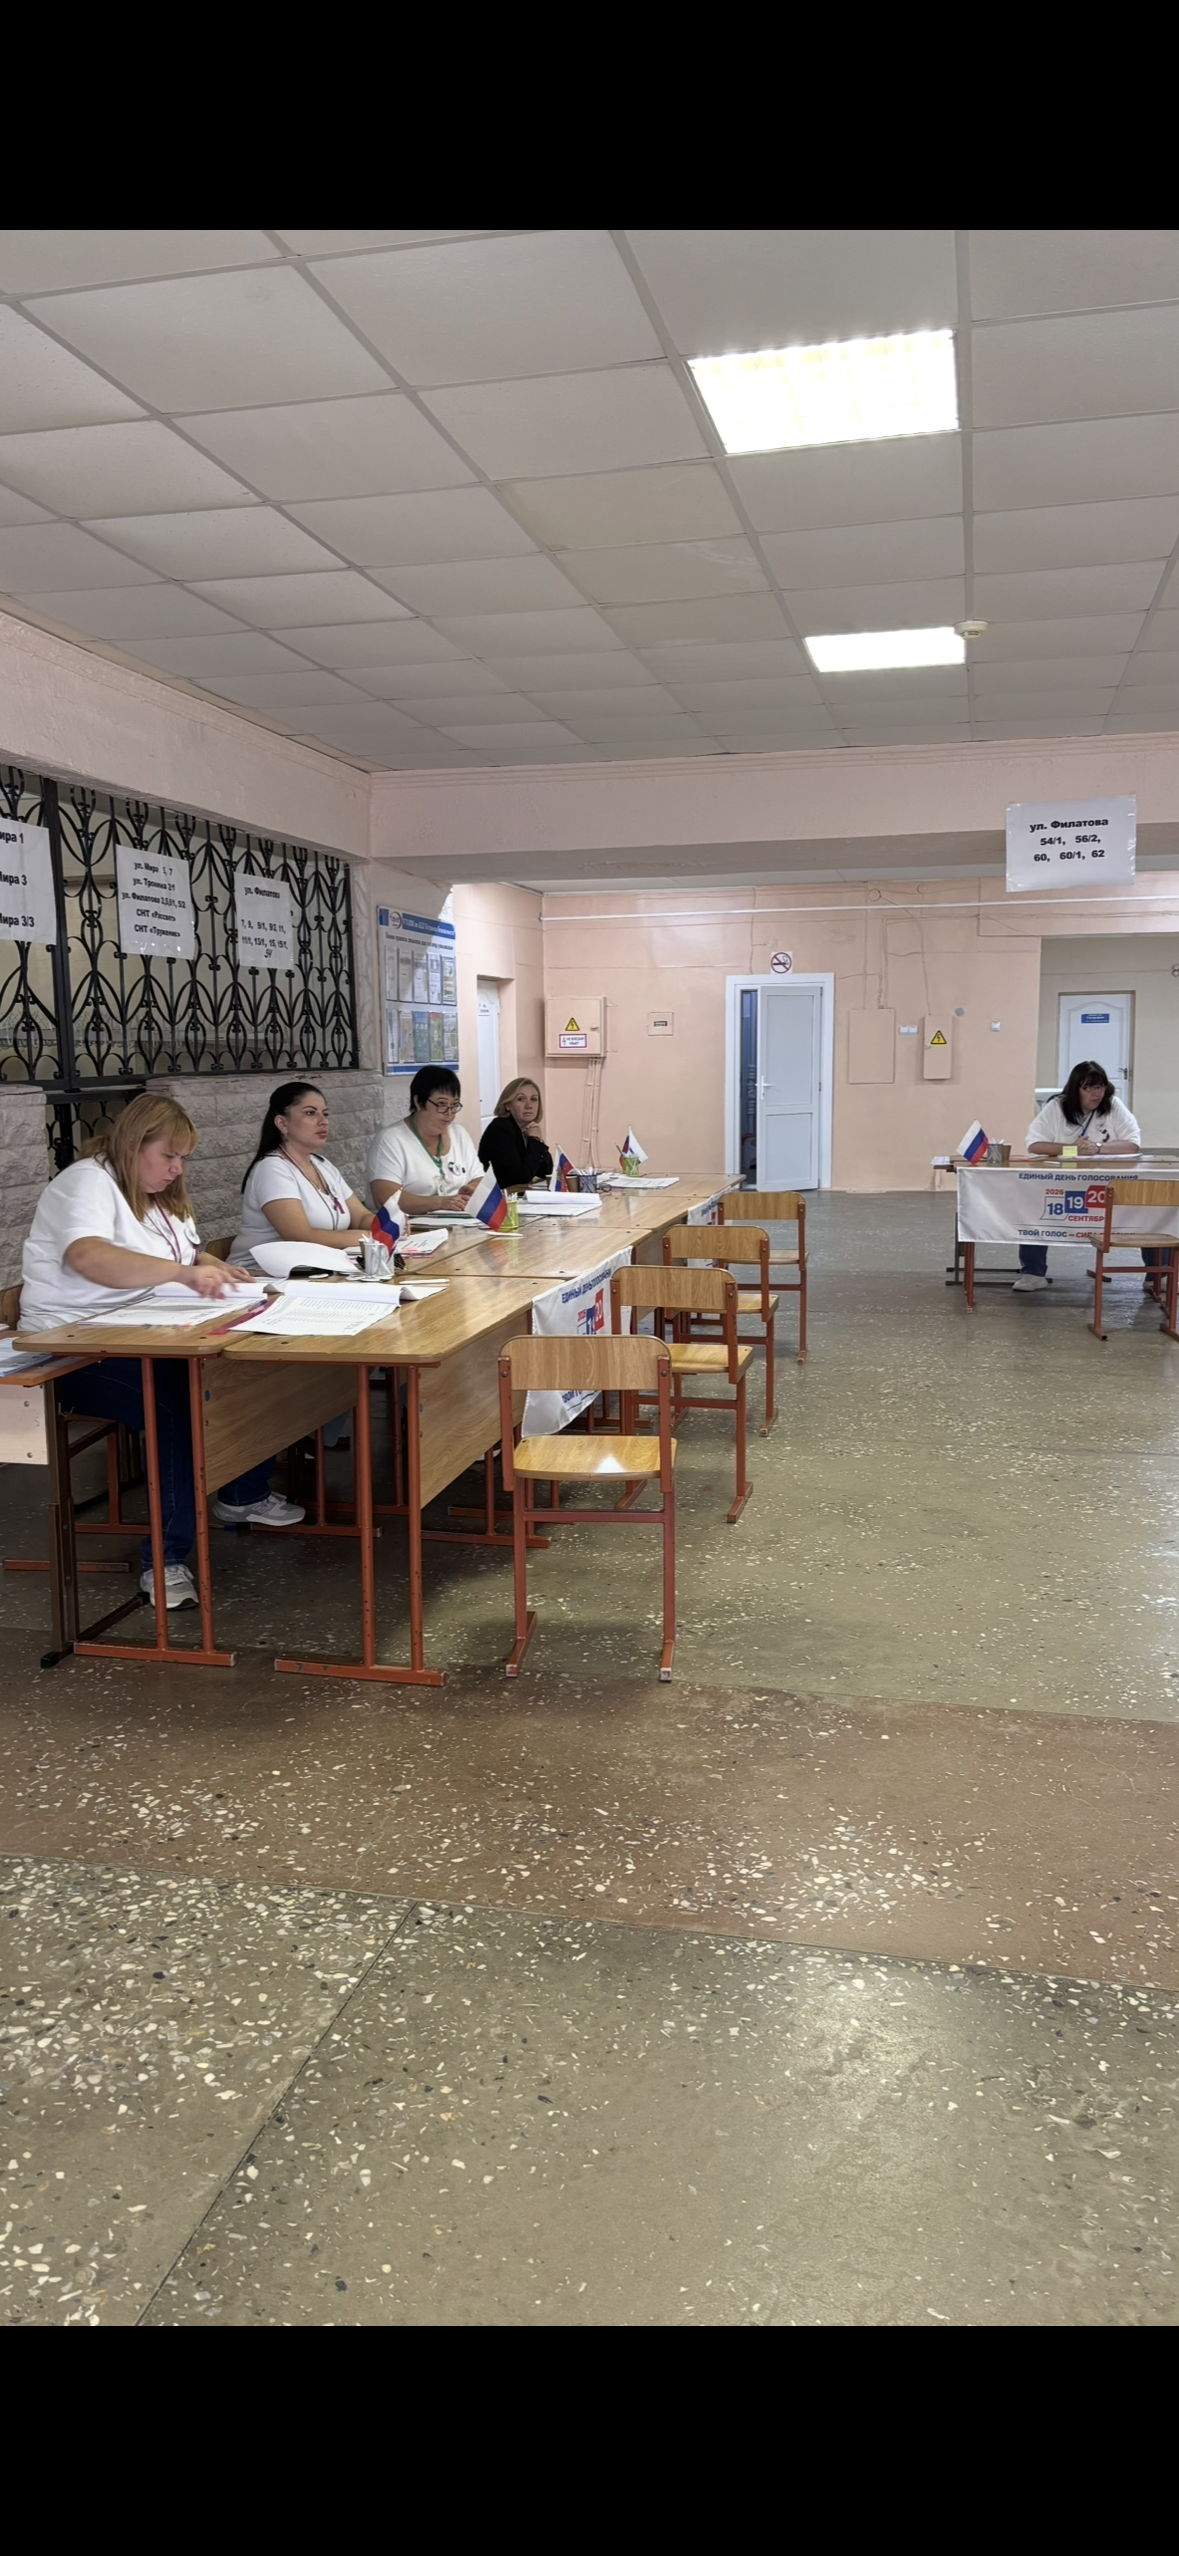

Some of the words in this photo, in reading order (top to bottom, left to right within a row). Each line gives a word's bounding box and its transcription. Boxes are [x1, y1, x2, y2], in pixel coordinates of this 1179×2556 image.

[1029, 823, 1048, 833] ул.
[1050, 819, 1109, 829] Филатова
[0, 831, 17, 844] ира
[19, 832, 24, 844] 1
[1040, 836, 1066, 846] 54/1,
[1075, 834, 1101, 844] 56/2,
[1033, 853, 1051, 862] 60,
[1059, 851, 1086, 860] 60/1,
[1091, 849, 1105, 858] 62
[134, 862, 144, 870] ул.
[144, 862, 159, 873] Мира
[0, 871, 20, 886] ира
[21, 874, 28, 886] 3
[132, 878, 143, 886] ул.
[121, 892, 131, 900] ул.
[244, 887, 253, 896] ул.
[136, 908, 151, 918] СНТ
[0, 913, 20, 928] ира
[21, 915, 35, 928] 3/3
[134, 924, 148, 933] СНТ
[1047, 1202, 1064, 1215] 18
[1066, 1196, 1084, 1209] 19
[1087, 1191, 1106, 1203] 20
[1018, 1229, 1040, 1237] ТВОЙ
[1041, 1230, 1068, 1238] ГОЛОС
